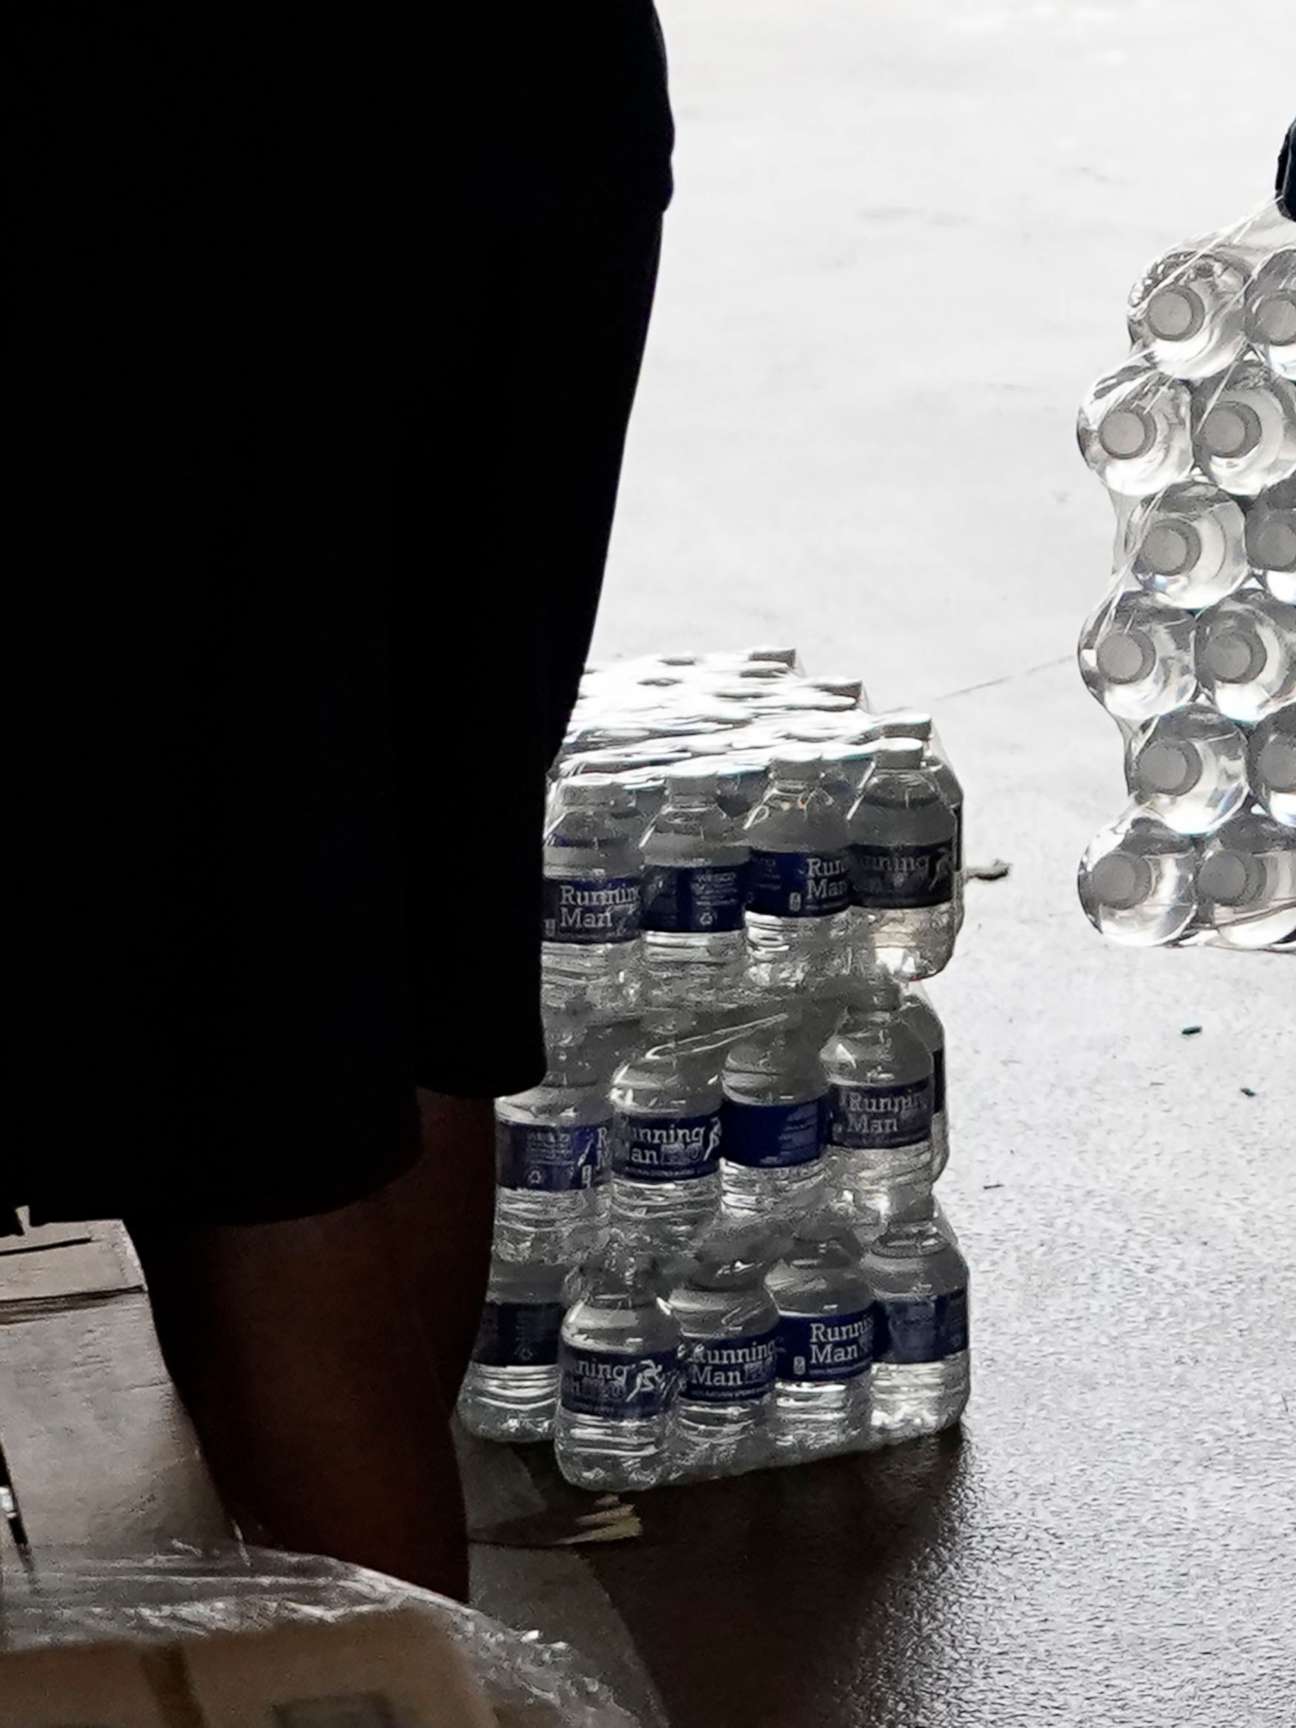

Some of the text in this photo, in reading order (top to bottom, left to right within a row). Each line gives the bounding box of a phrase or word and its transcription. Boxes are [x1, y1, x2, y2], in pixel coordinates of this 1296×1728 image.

[560, 907, 613, 928] Man
[847, 1113, 898, 1133] Man
[626, 1146, 658, 1165] an
[809, 1344, 858, 1364] Man
[690, 1365, 743, 1386] Man
